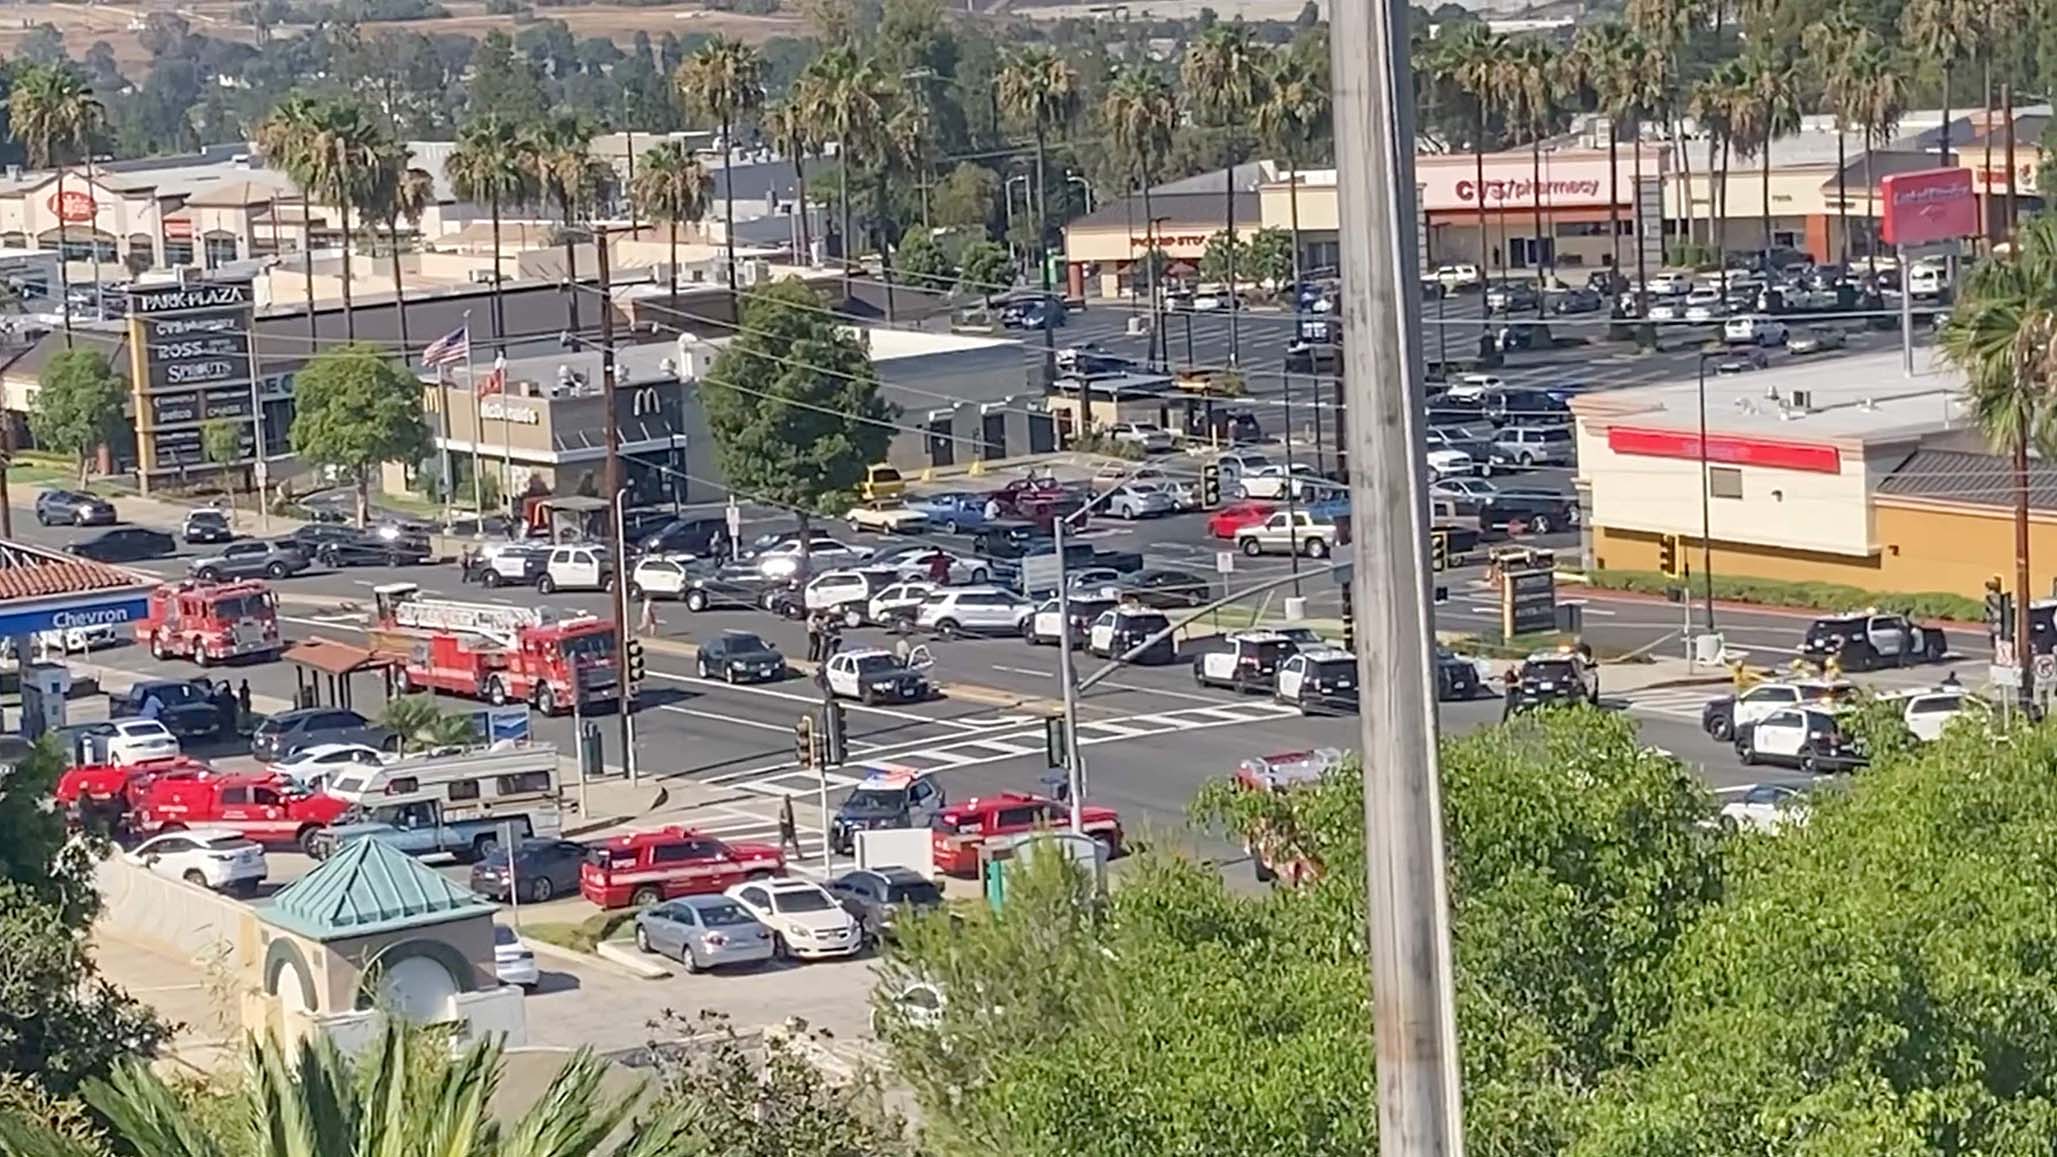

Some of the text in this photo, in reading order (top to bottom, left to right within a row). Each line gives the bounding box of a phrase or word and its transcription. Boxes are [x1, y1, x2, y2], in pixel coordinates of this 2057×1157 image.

[141, 287, 244, 312] PARK PLAZA
[157, 341, 203, 360] ROSS
[53, 608, 128, 628] Chevron
